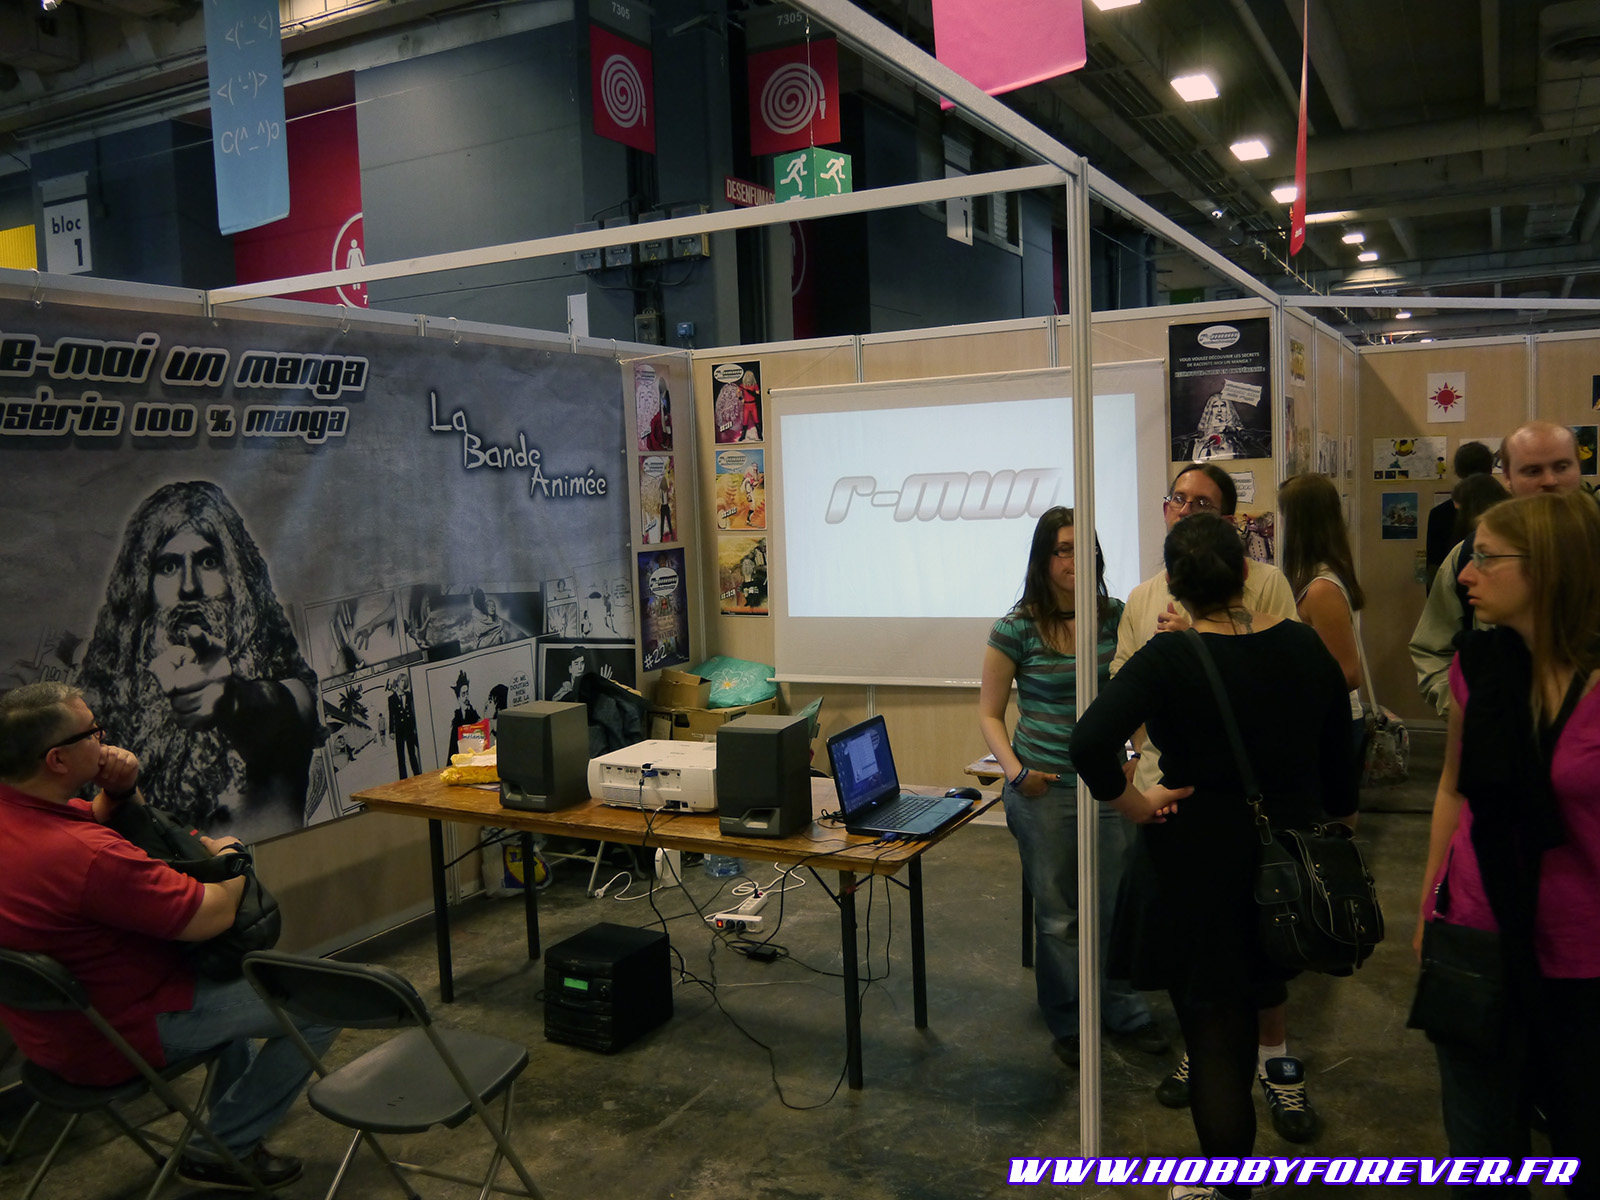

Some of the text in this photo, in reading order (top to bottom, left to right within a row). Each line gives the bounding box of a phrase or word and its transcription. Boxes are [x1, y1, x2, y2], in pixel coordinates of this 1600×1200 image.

[611, 2, 631, 20] 7305
[777, 13, 803, 26] 7305
[52, 215, 81, 235] bloc
[963, 209, 968, 238] 1
[74, 238, 83, 266] 1
[162, 346, 229, 386] un
[235, 352, 368, 398] manga
[131, 403, 197, 436] 100
[206, 406, 236, 436] %
[242, 406, 349, 443] manga
[430, 391, 467, 432] La
[464, 432, 541, 469] Bande
[530, 464, 606, 497] Animée
[644, 644, 667, 669] #22
